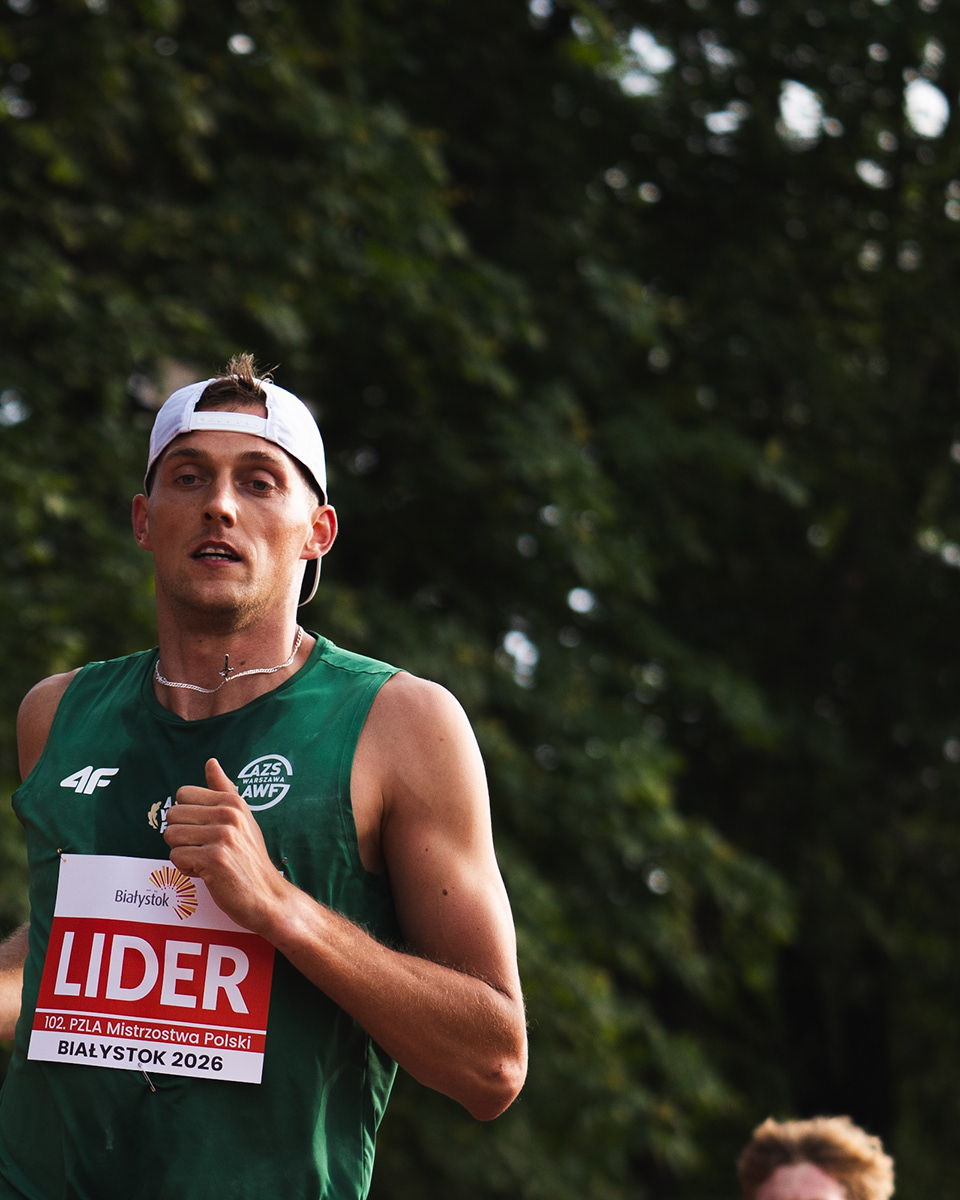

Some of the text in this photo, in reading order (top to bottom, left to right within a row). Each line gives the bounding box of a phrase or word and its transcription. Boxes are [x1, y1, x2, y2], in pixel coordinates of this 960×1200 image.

[60, 765, 119, 795] 4F
[242, 776, 285, 785] WARSZAWA
[249, 762, 282, 777] AZS
[241, 783, 280, 798] AWF
[115, 889, 170, 908] Białystok
[54, 931, 250, 1014] LIDER
[44, 1015, 252, 1050] 102. PZLA Mistrzostwa Polski
[57, 1040, 223, 1072] BIAŁYSTOK 2026
